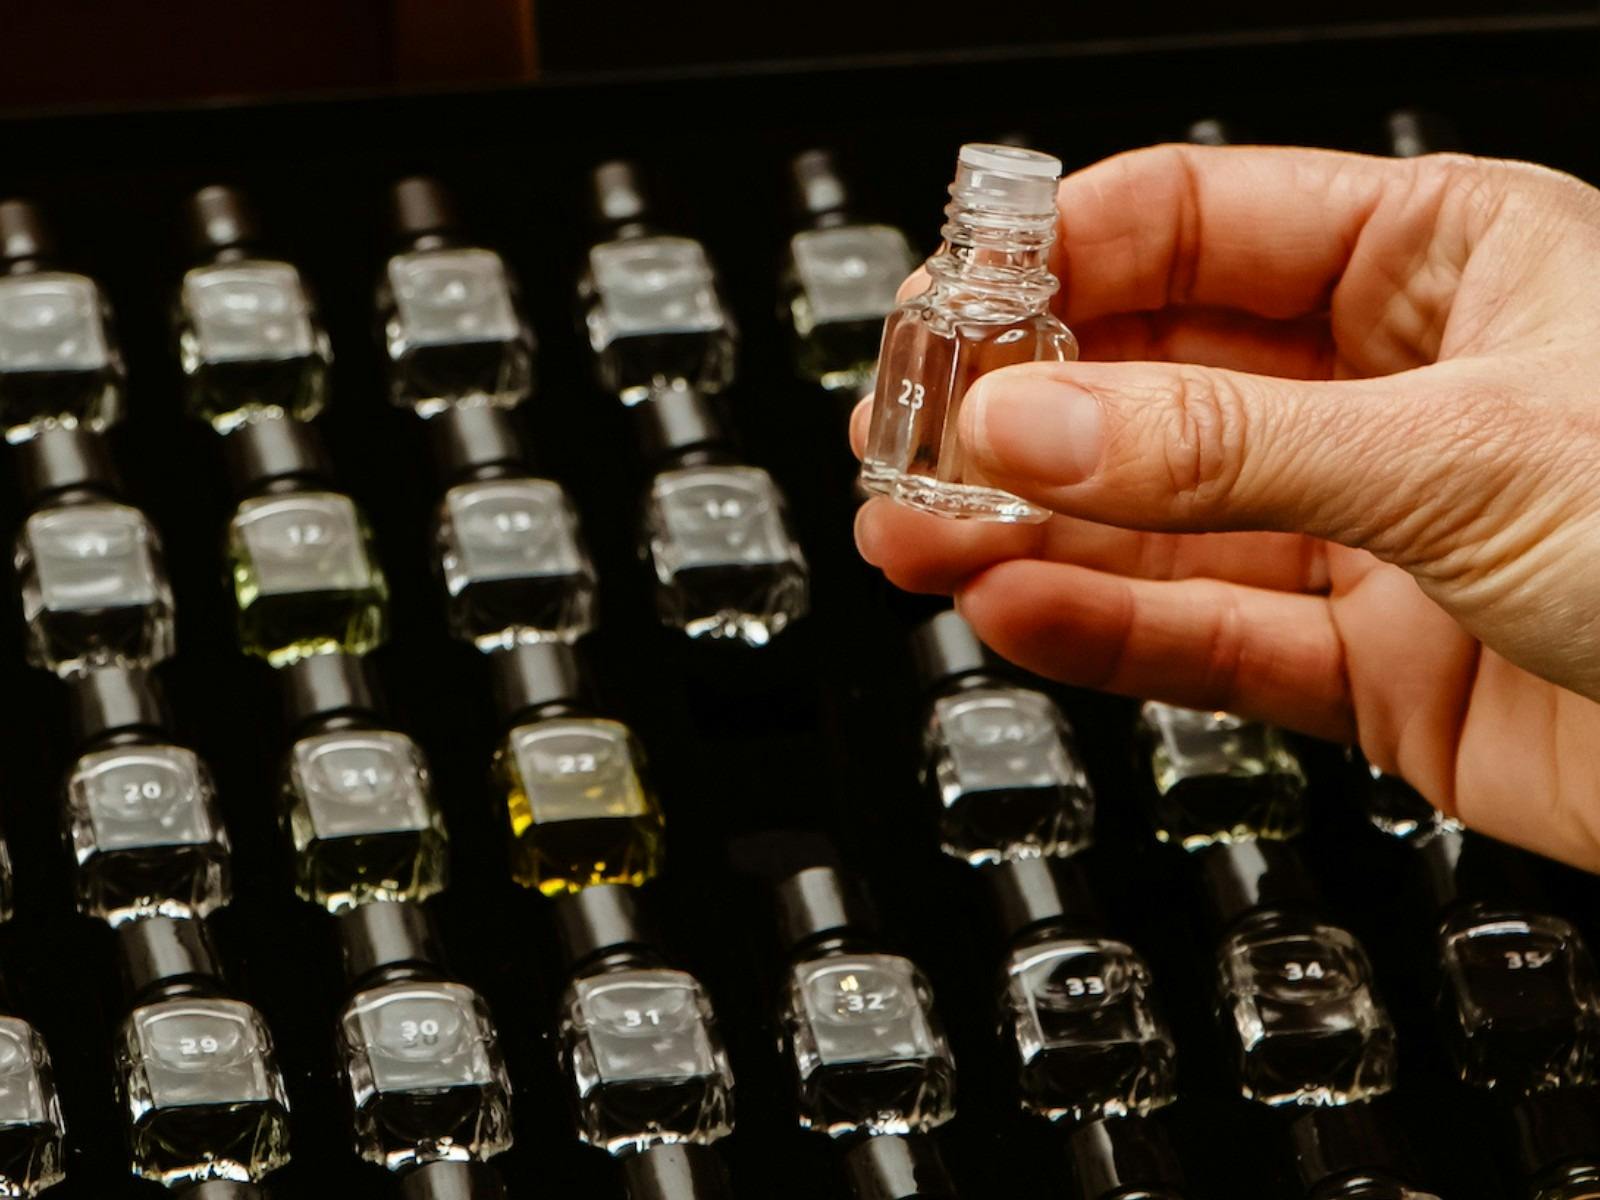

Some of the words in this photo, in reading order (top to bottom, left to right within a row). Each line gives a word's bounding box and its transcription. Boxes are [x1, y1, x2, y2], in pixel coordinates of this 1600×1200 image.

[898, 378, 925, 410] 23
[558, 754, 595, 773] 22
[342, 767, 378, 787] 21
[123, 781, 160, 804] 20
[1285, 960, 1325, 981] 34
[1506, 951, 1544, 970] 35
[1065, 976, 1104, 996] 33
[847, 993, 884, 1012] 32
[401, 1018, 438, 1038] 30
[624, 1009, 660, 1027] 31
[180, 1037, 219, 1055] 29
